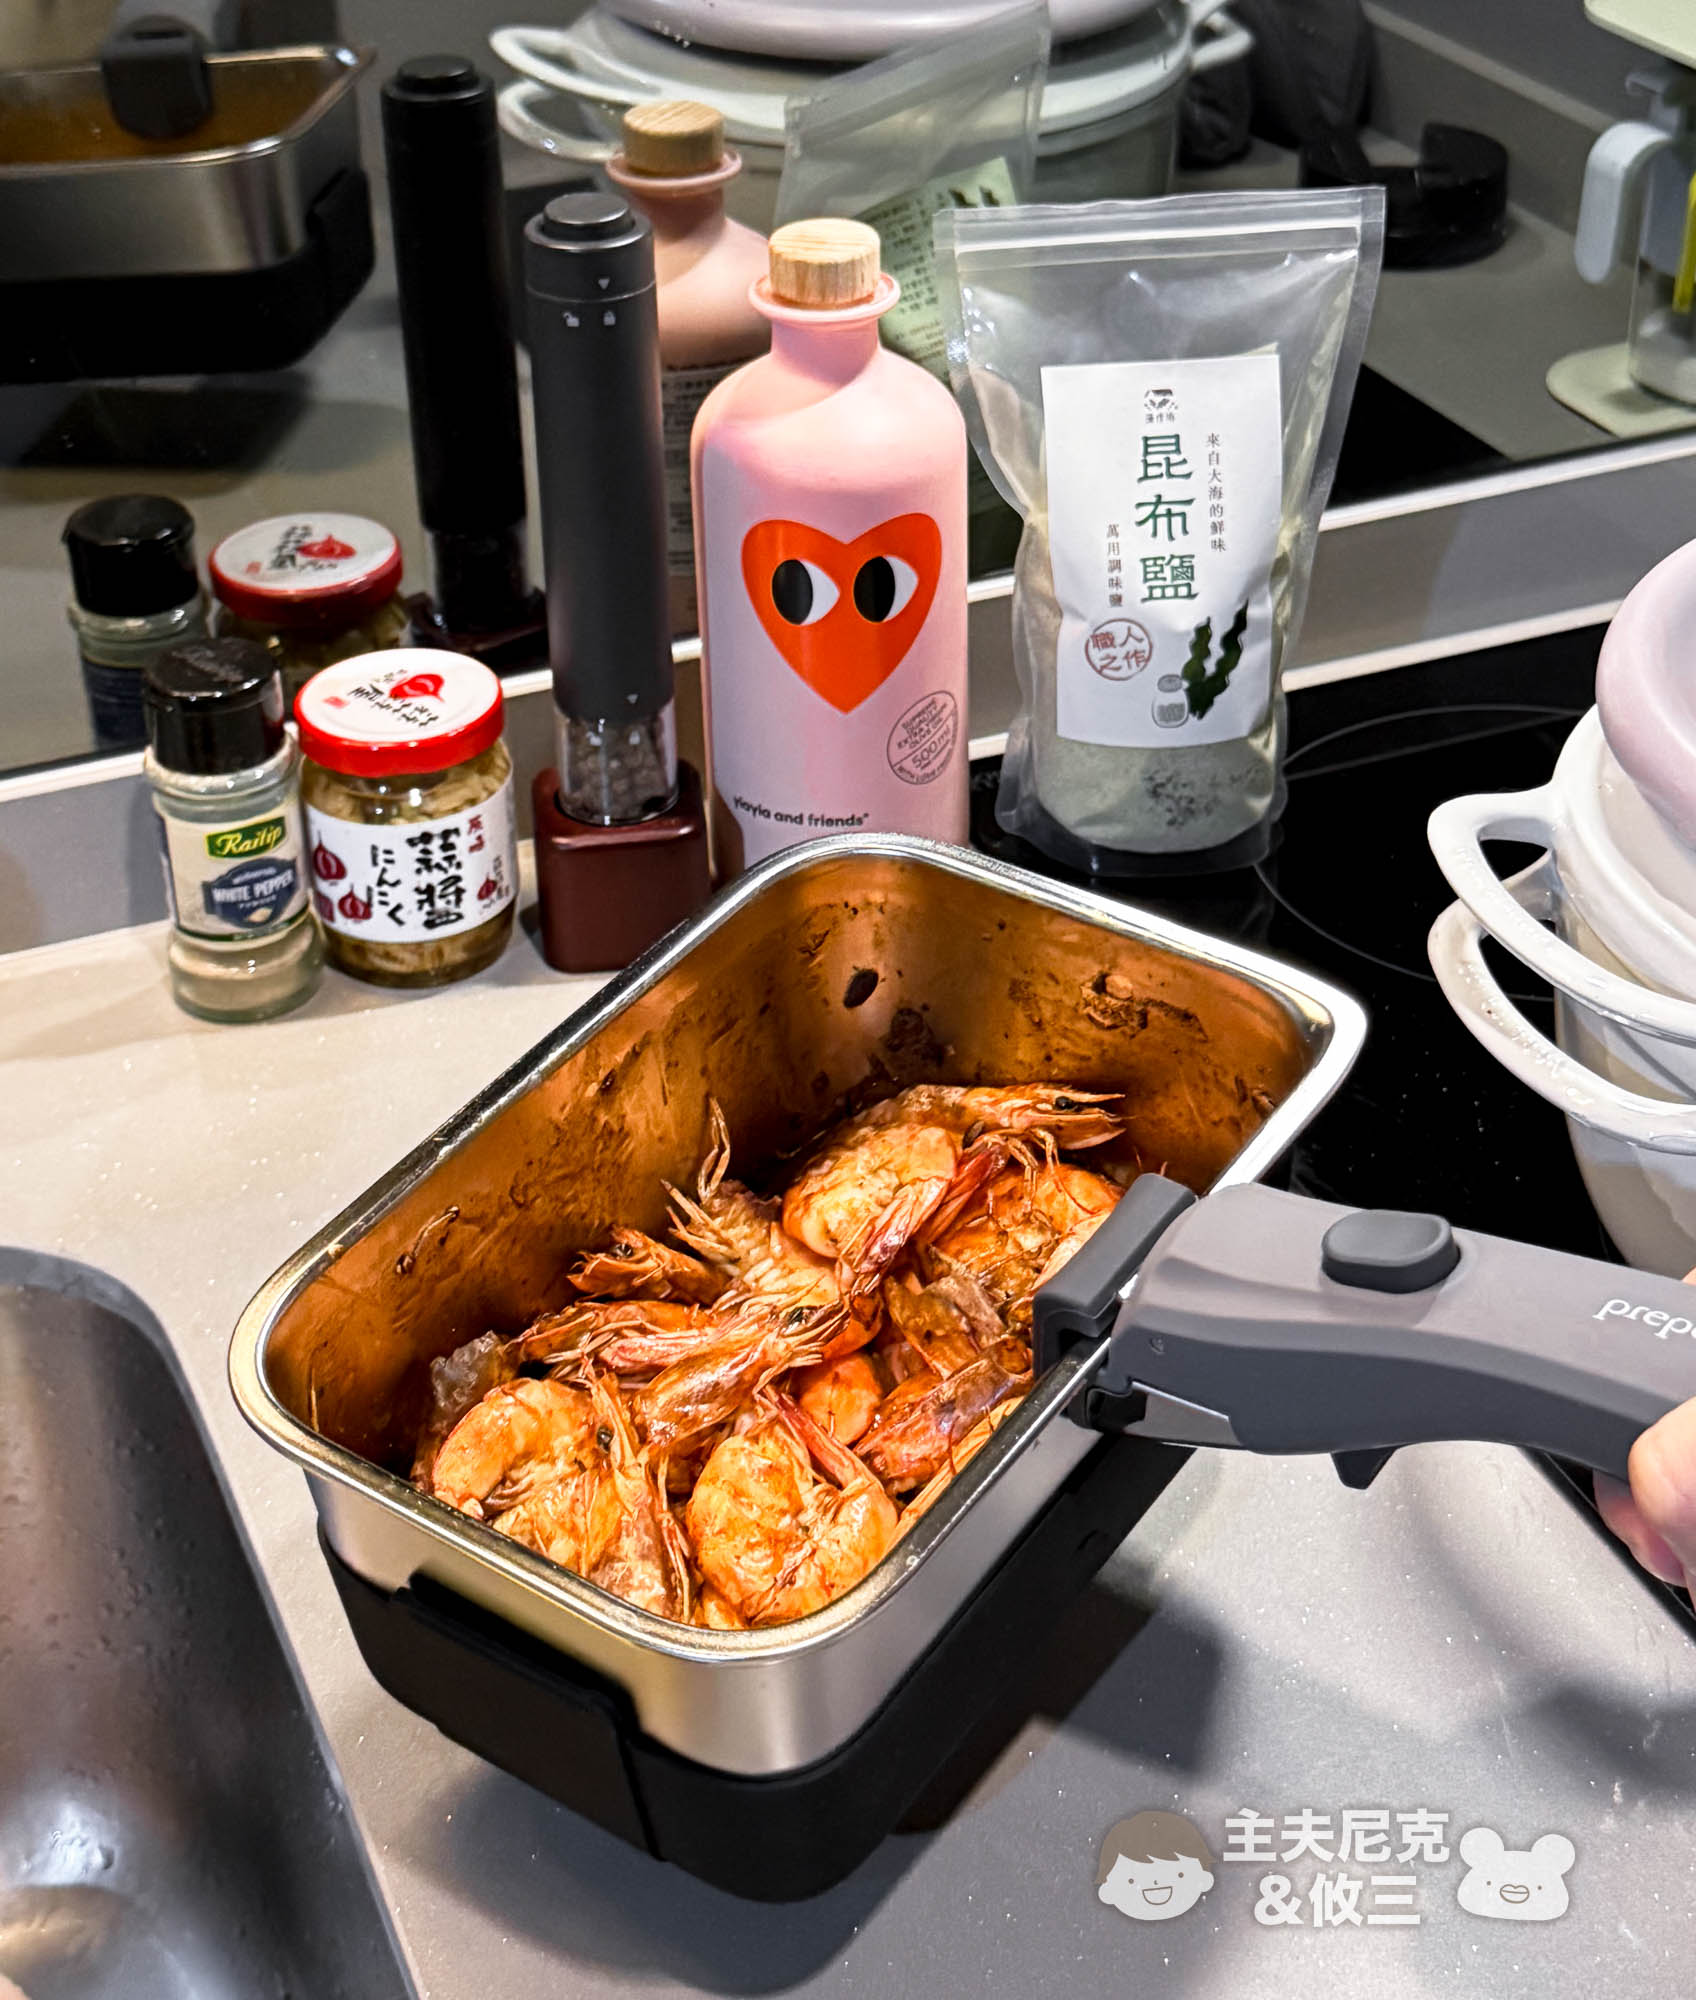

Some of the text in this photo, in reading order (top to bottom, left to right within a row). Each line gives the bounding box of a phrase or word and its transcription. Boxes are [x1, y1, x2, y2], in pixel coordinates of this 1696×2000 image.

[1135, 433, 1199, 603] 昆布鹽
[1206, 432, 1227, 552] 來自大海的鮮味
[911, 741, 939, 769] 500
[774, 812, 804, 826] and
[212, 885, 250, 903] WHITE
[253, 868, 294, 898] PEPPER
[365, 843, 406, 927] にんにく
